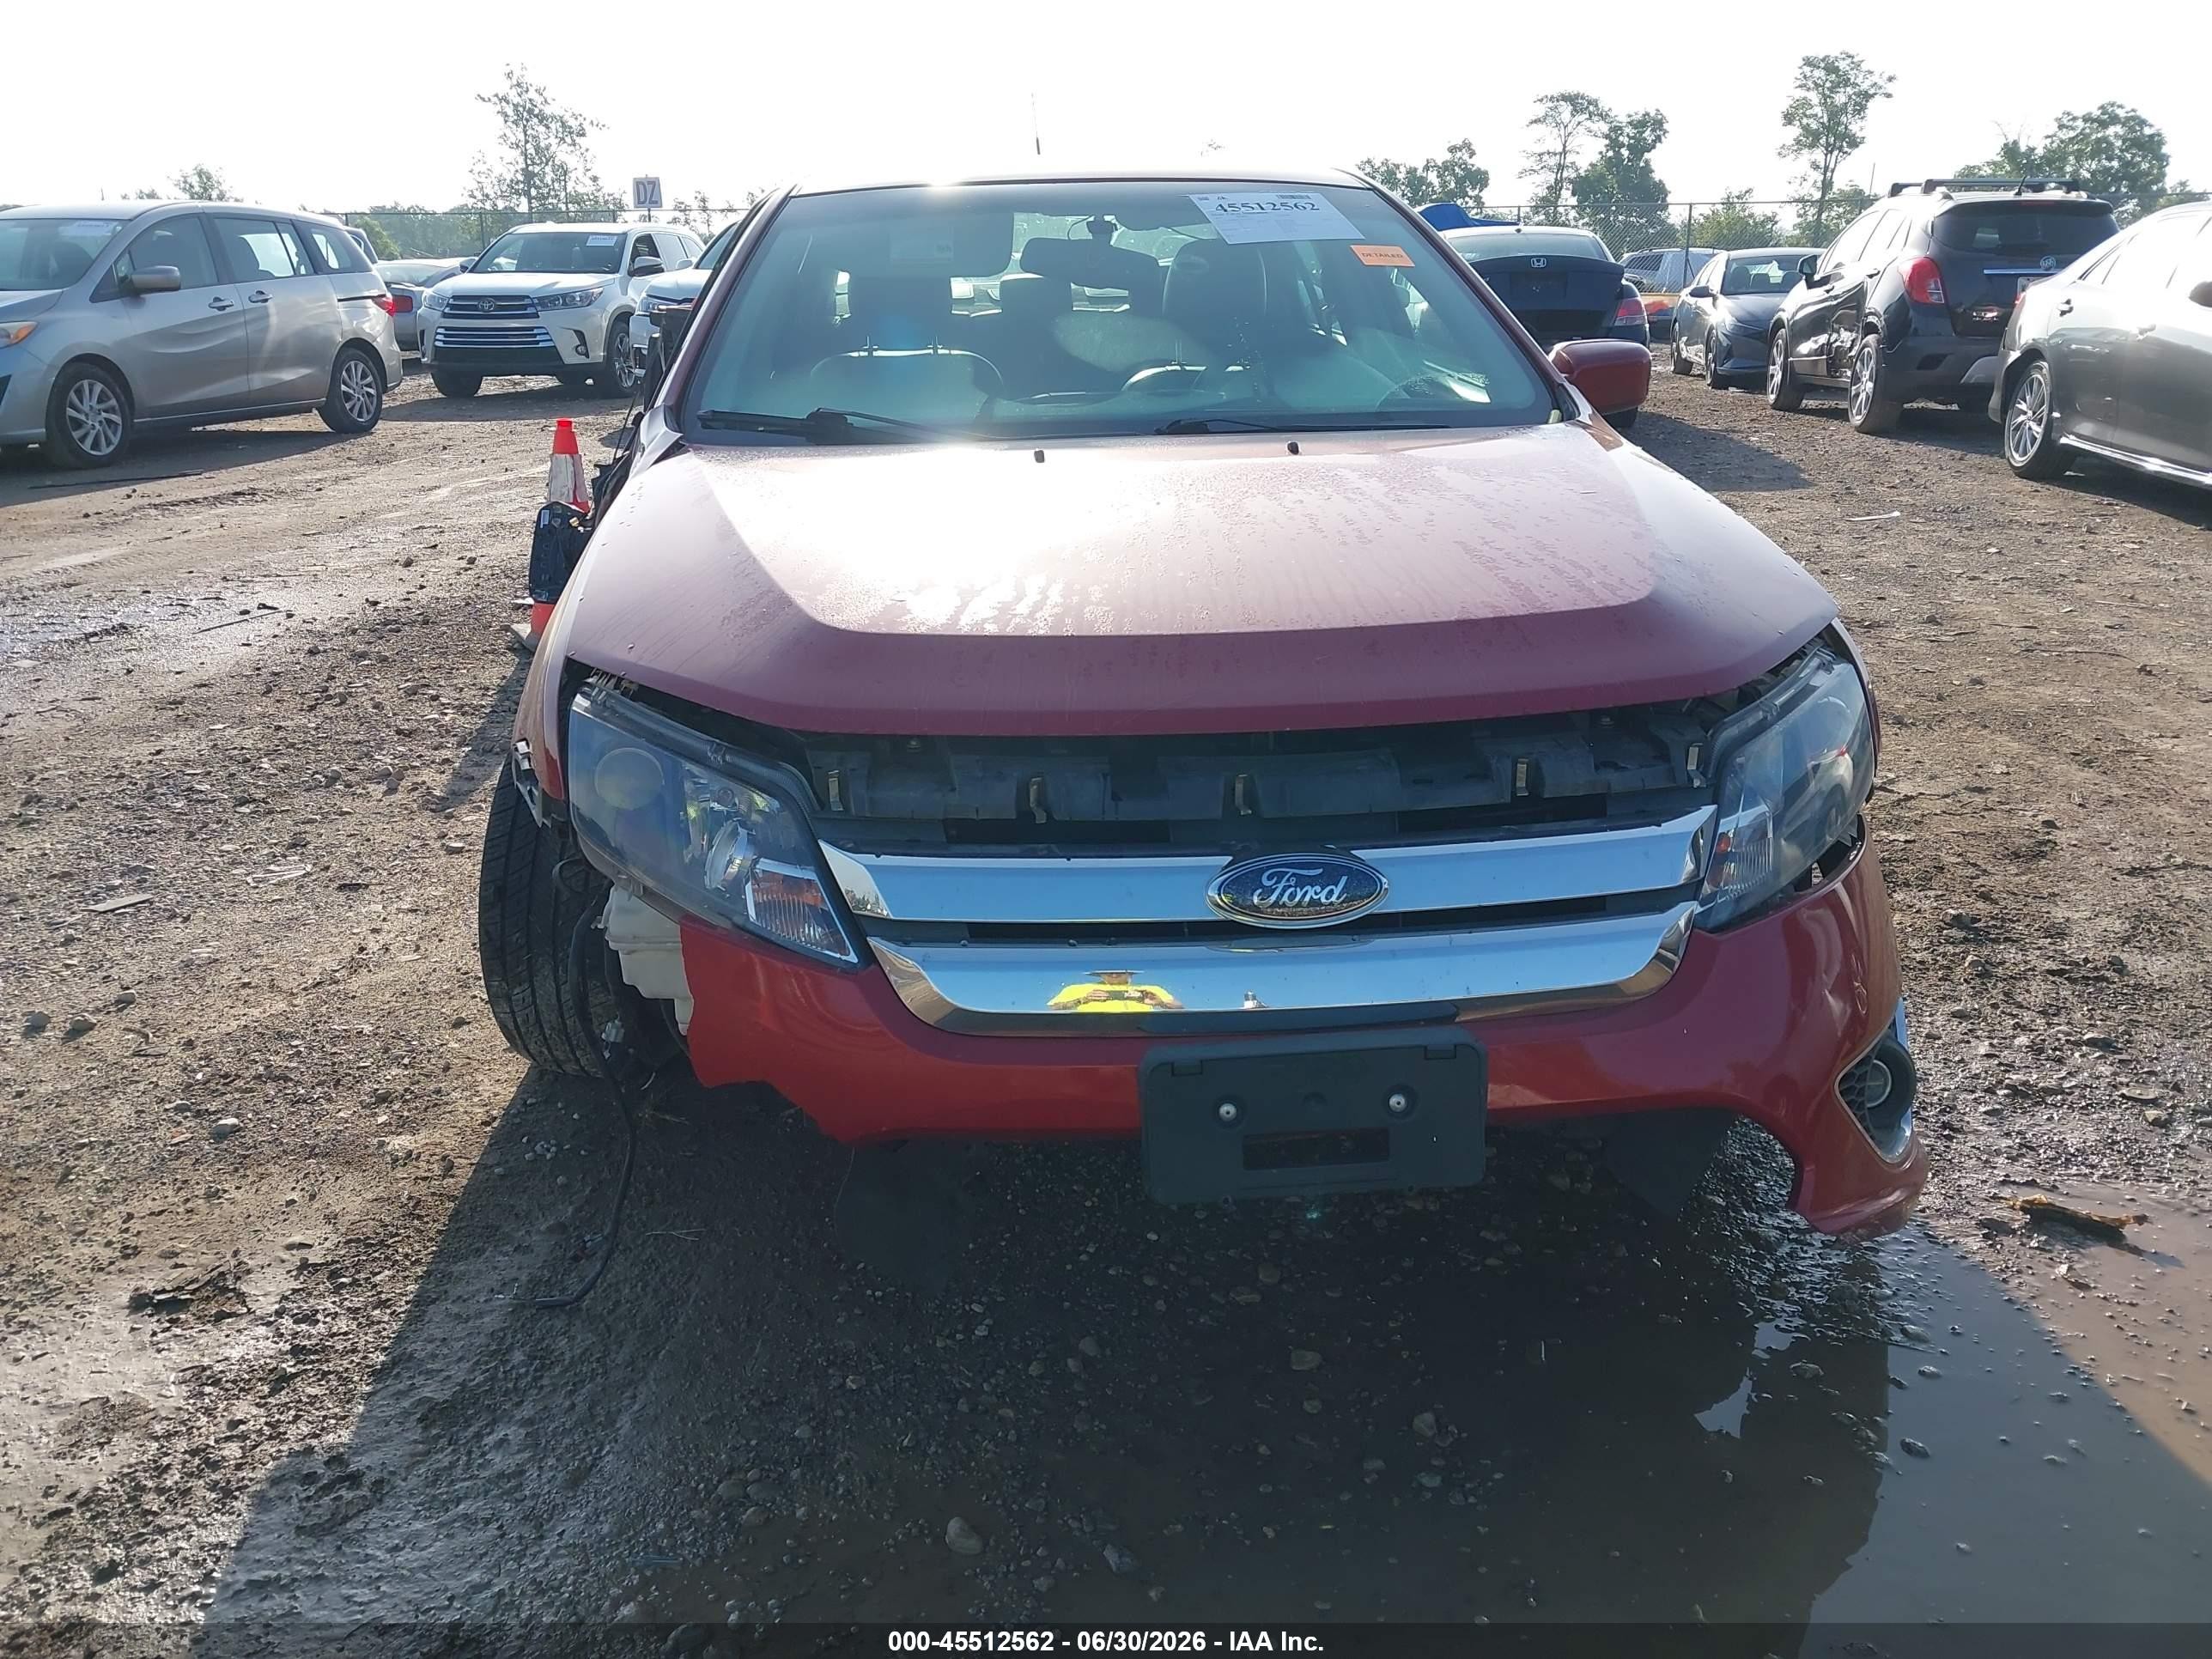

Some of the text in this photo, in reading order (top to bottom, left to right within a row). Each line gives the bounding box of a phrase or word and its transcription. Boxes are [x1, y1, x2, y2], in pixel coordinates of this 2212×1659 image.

[635, 180, 659, 205] DZ
[1215, 202, 1320, 213] 45512562
[1252, 867, 1348, 908] Ford
